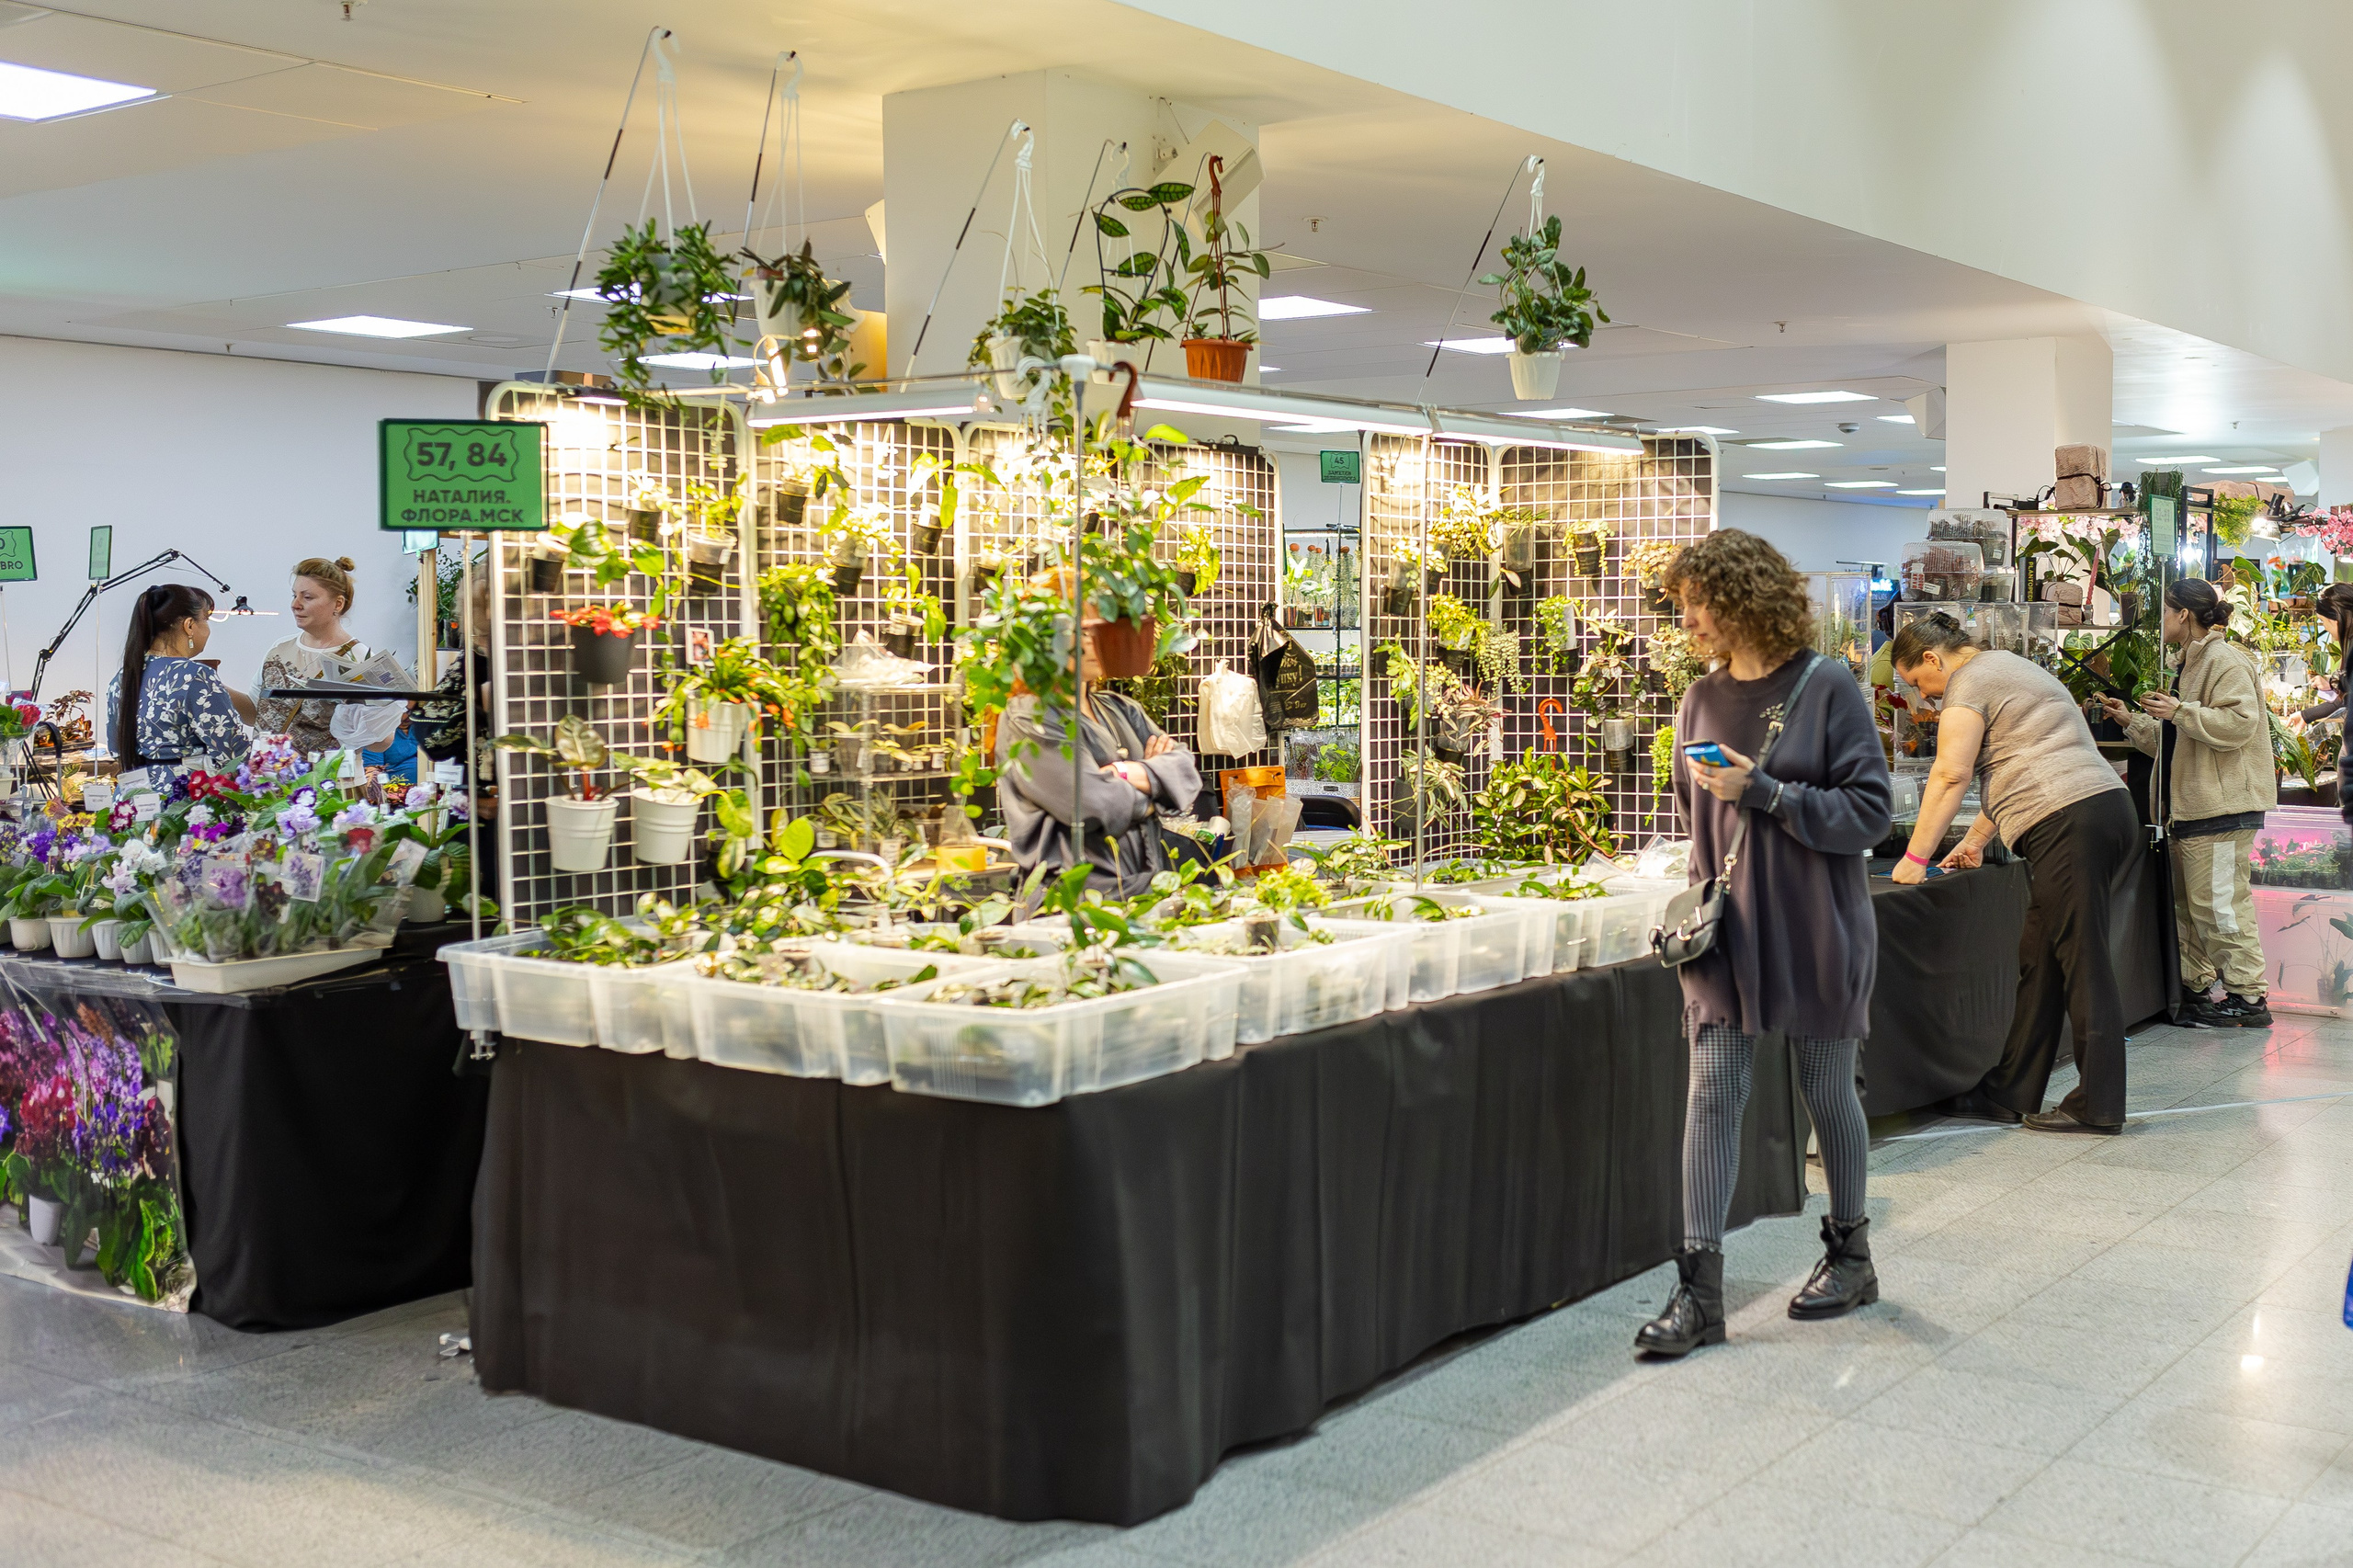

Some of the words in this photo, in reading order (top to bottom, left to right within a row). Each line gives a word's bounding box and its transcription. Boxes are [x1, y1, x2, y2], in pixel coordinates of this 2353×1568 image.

[416, 442, 456, 471] 57,
[466, 442, 507, 467] 84
[413, 490, 511, 504] НАТАЛИЯ.
[401, 508, 524, 523] ФЛОРА.МСК
[0, 561, 23, 570] BRO
